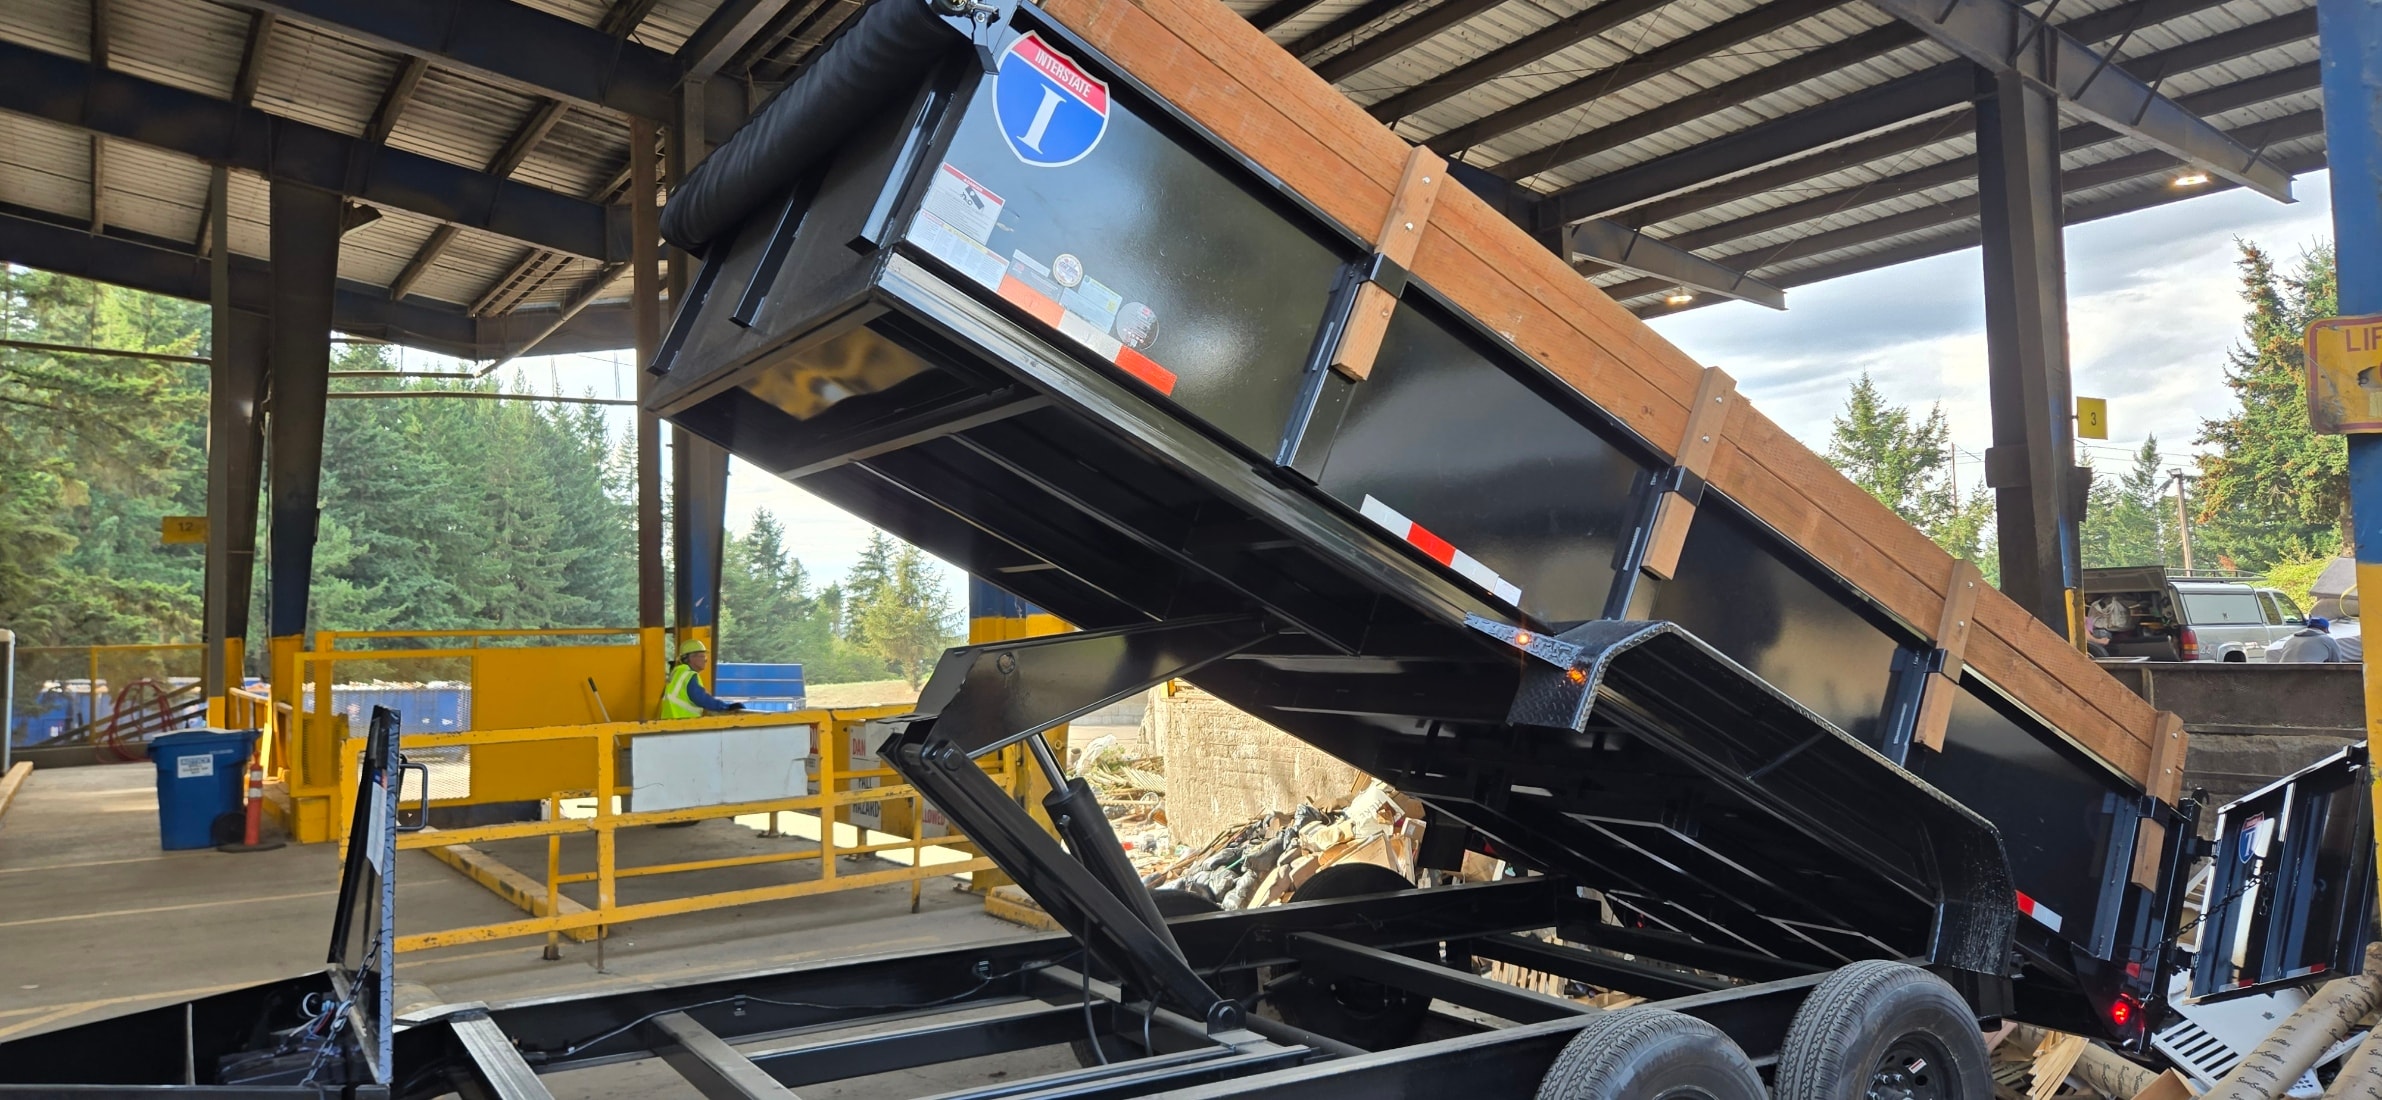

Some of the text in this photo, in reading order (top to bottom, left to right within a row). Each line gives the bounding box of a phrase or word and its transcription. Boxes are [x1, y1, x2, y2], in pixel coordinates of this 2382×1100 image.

[1035, 49, 1093, 98] INTERSTATE
[2090, 411, 2097, 426] 3
[178, 521, 193, 532] 12
